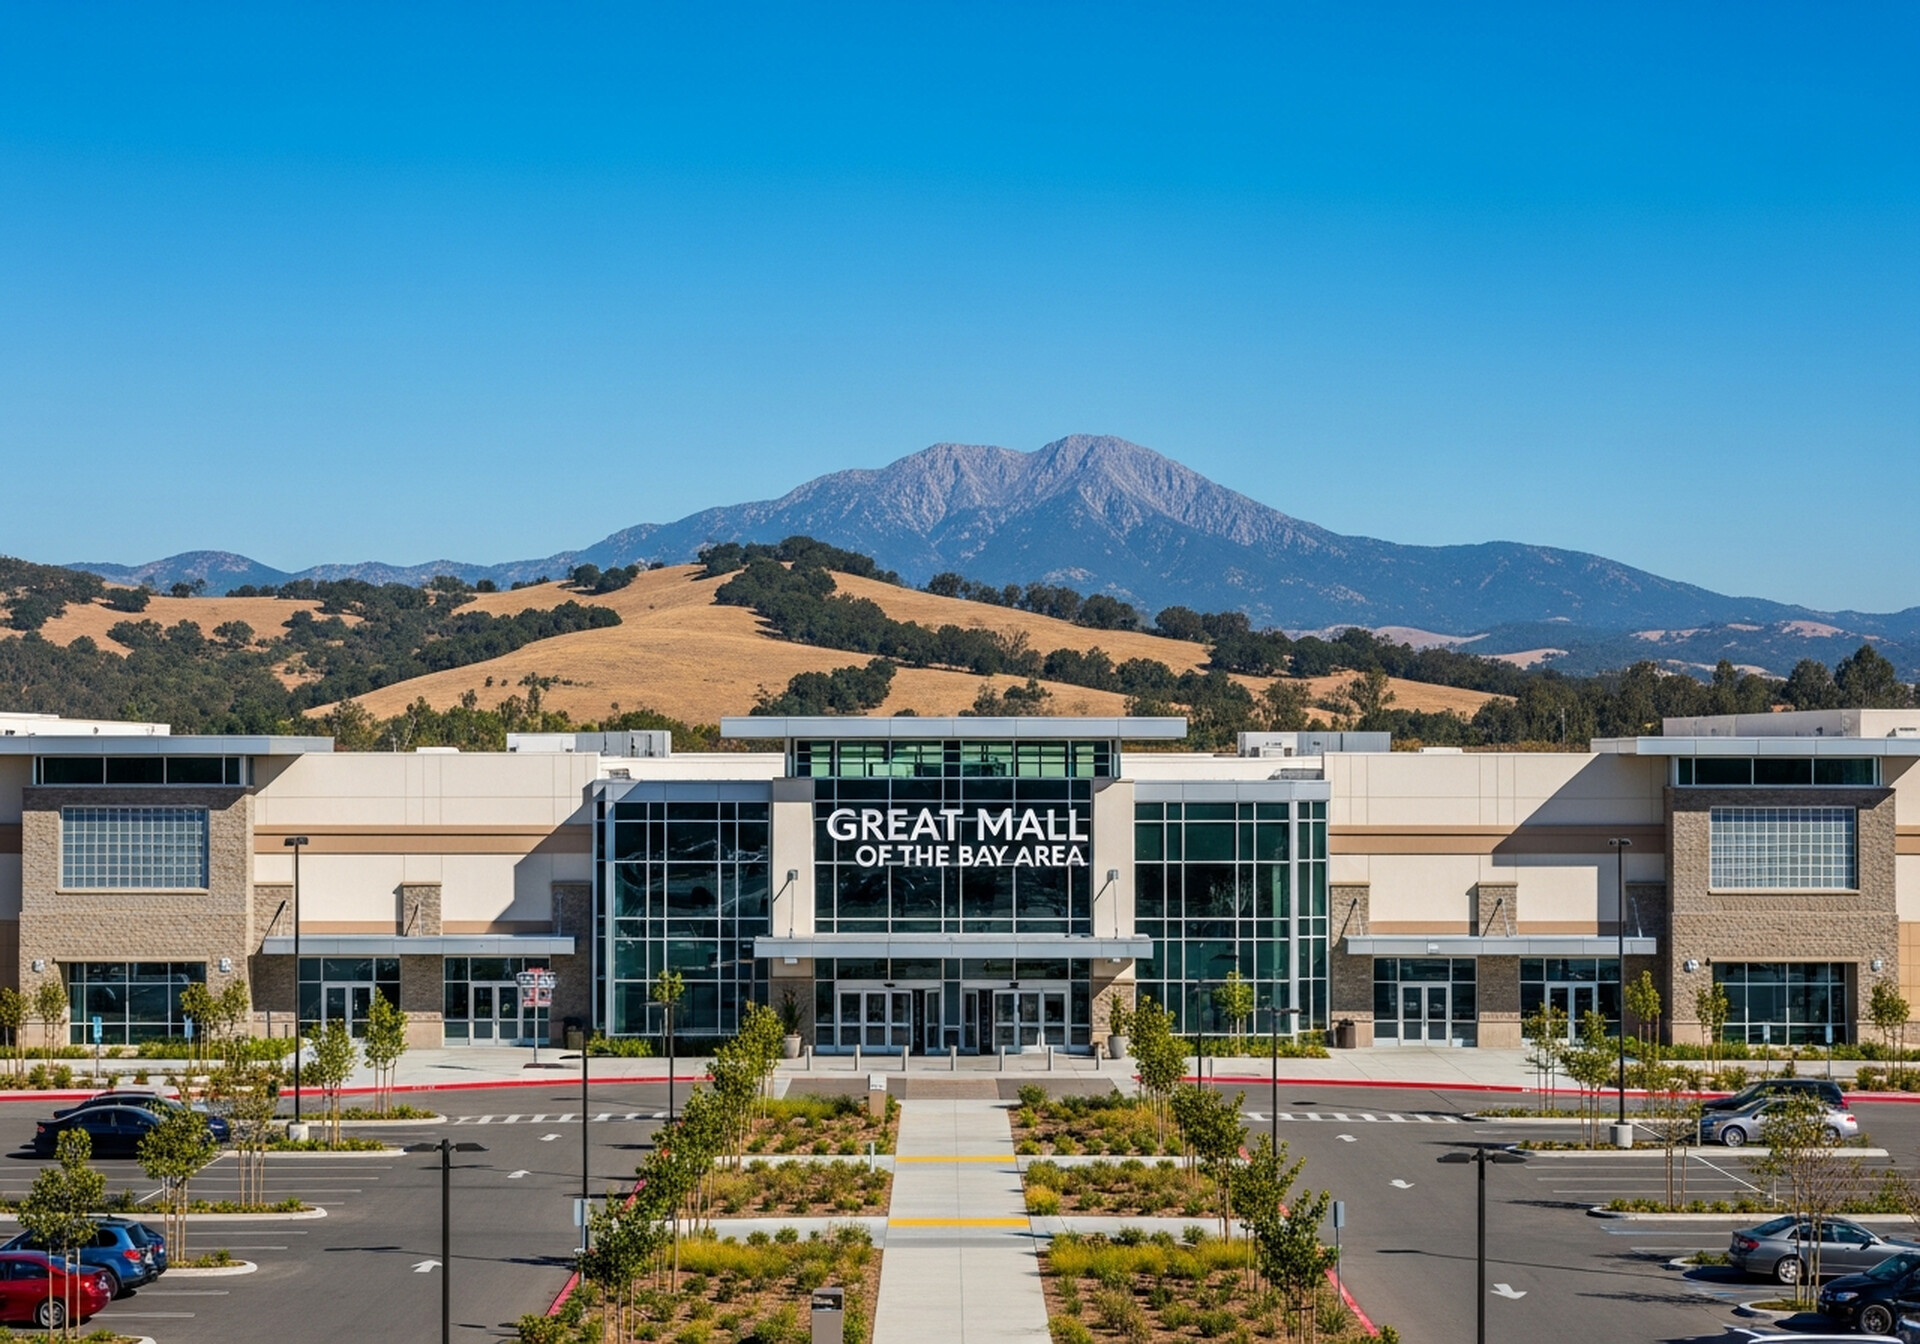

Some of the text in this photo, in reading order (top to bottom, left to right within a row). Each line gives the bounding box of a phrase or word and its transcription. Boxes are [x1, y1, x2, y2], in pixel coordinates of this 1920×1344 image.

[826, 808, 1088, 841] GREAT MALL
[855, 845, 1086, 867] OF THE BAY AREA
